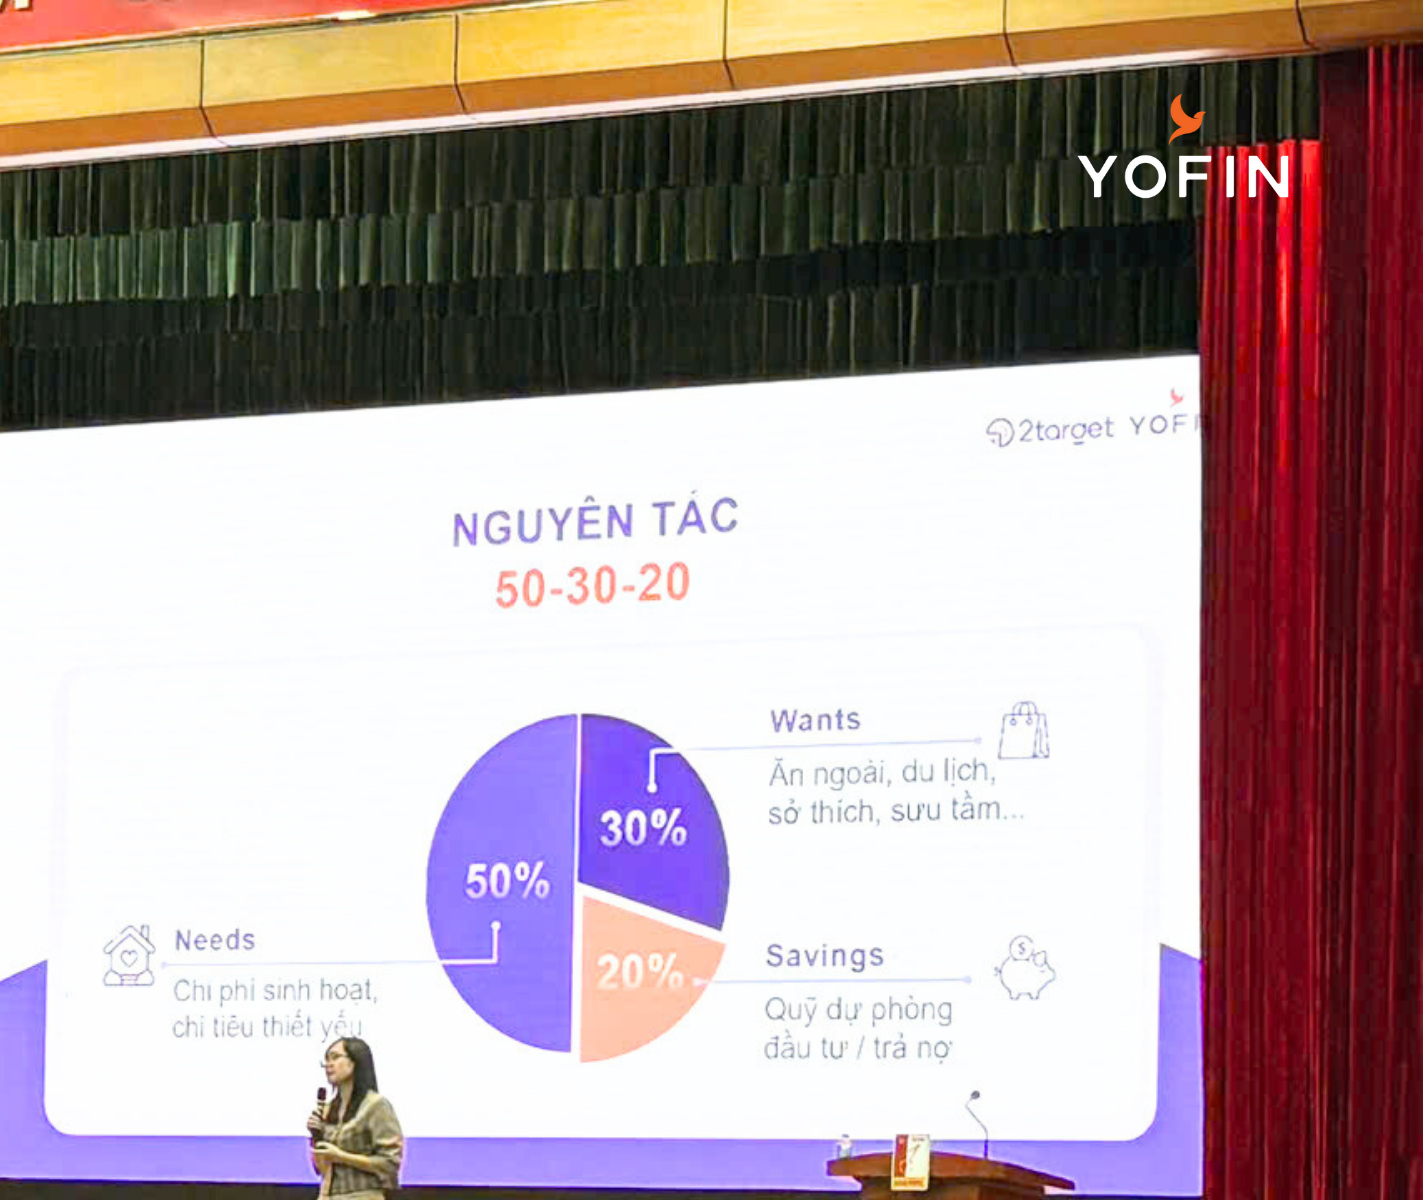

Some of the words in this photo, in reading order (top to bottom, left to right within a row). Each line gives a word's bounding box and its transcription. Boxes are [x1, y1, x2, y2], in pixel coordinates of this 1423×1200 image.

[453, 495, 634, 548] NGUYÊN
[495, 561, 691, 609] 50-30-20
[770, 708, 862, 733] Wants
[768, 756, 804, 787] Ăn
[901, 758, 935, 784] du
[943, 758, 997, 787] lịch,
[600, 807, 688, 847] 30%
[465, 860, 551, 900] 50%
[175, 928, 255, 951] Needs
[597, 952, 685, 990] 20%
[766, 943, 885, 973] Savings
[173, 978, 212, 1002] Chi
[263, 978, 311, 1002] sinh
[172, 1014, 205, 1038] chi
